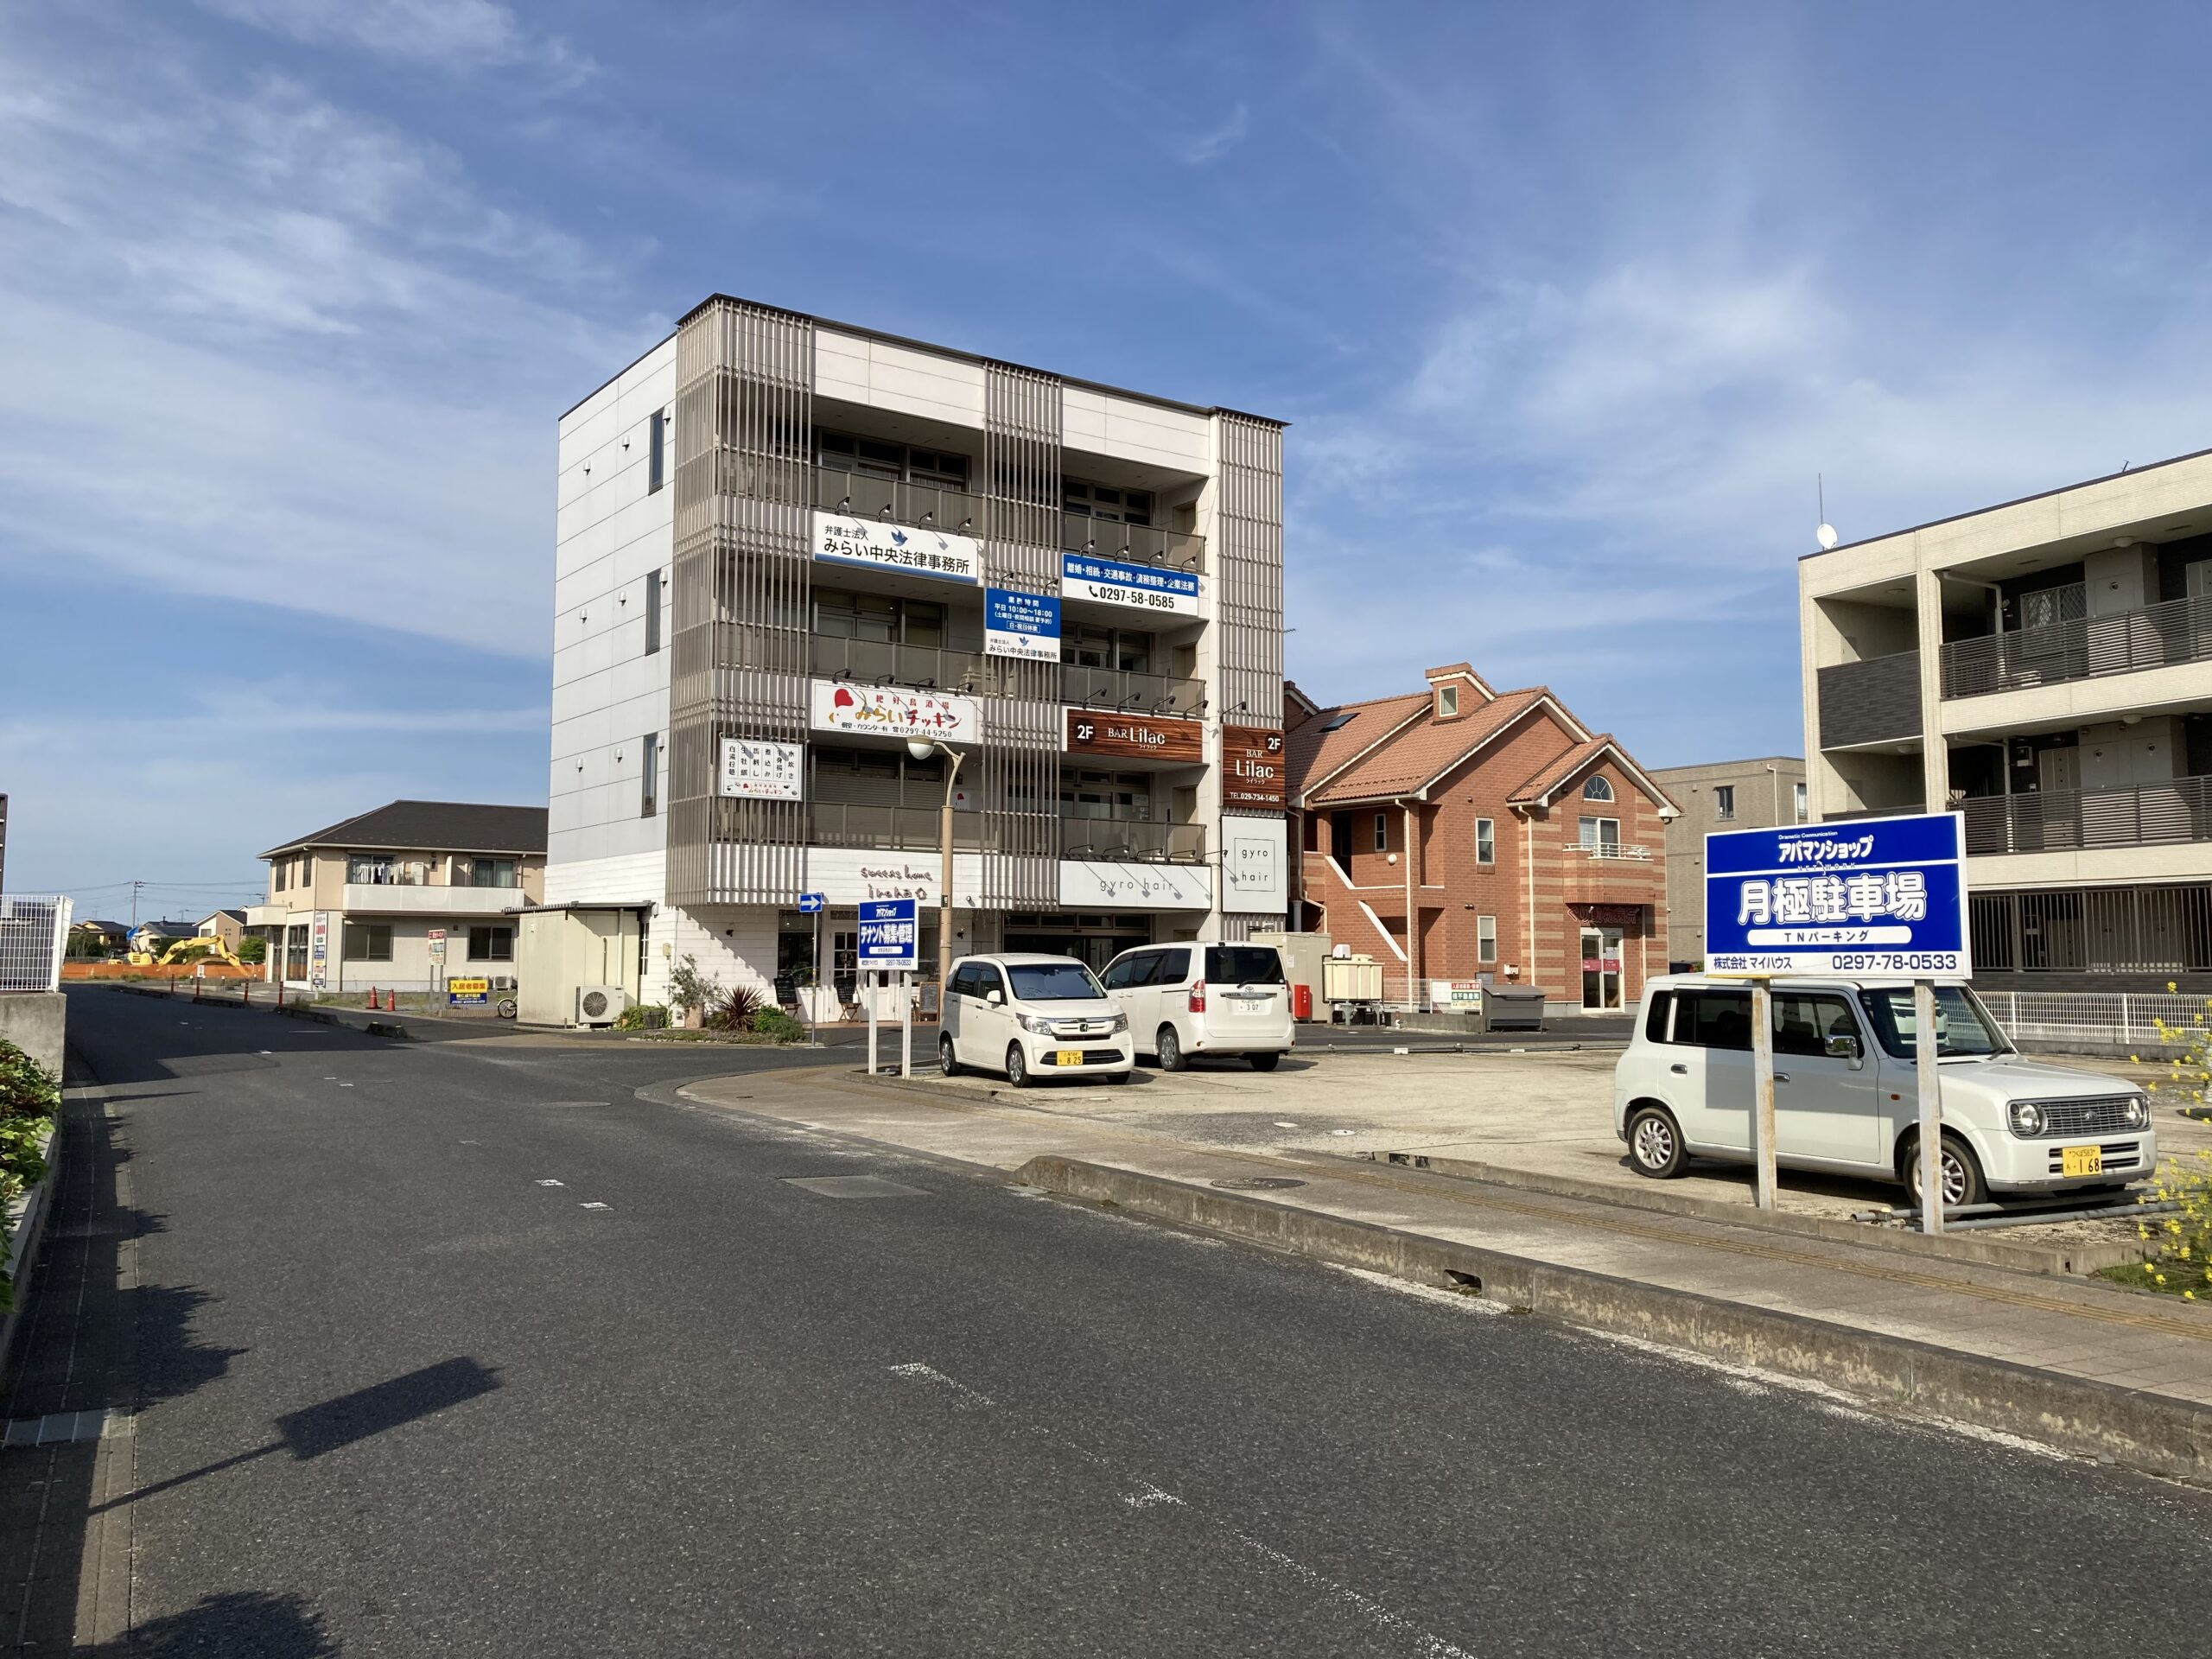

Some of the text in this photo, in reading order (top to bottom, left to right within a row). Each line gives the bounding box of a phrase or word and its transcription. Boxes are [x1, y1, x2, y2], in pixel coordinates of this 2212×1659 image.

[824, 525, 869, 541] 弁護士法人
[823, 537, 969, 574] みらい中央法律事務所
[1007, 595, 1039, 607] 業務時間
[1099, 587, 1175, 608] 0297-58-0585
[988, 644, 1058, 660] みらい中央法律事務所
[1077, 725, 1166, 744] 2F BAR Lilac
[1268, 737, 1281, 750] 2F
[1246, 748, 1263, 759] BAR
[1236, 760, 1274, 779] Lilac
[1242, 849, 1268, 859] gyro
[1778, 835, 1874, 863] アパマンショップ
[1242, 871, 1268, 881] hair
[1100, 878, 1173, 892] gyro hair
[1738, 872, 1927, 925] 月極駐車場
[1784, 930, 1869, 943] TNパーキング
[1713, 954, 1957, 970] 株式会社 マイハウス 0297-78-0533
